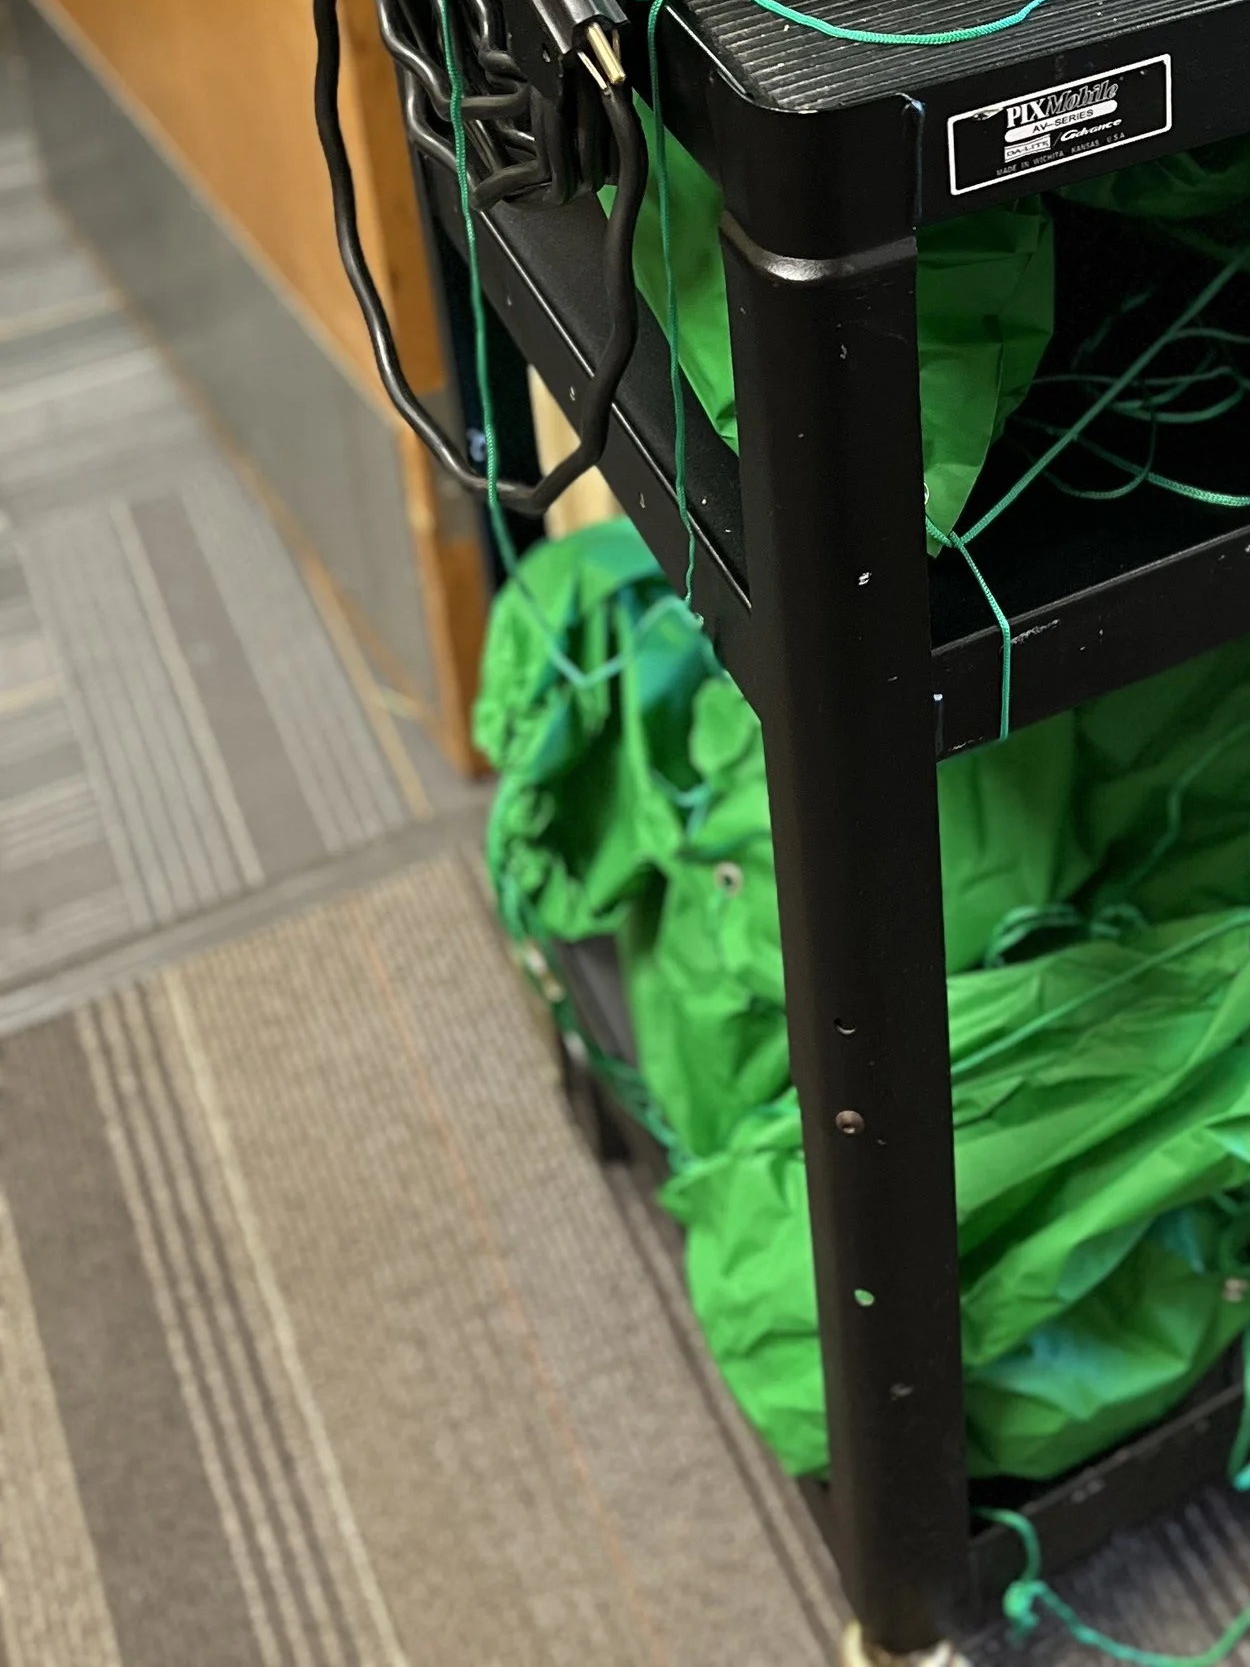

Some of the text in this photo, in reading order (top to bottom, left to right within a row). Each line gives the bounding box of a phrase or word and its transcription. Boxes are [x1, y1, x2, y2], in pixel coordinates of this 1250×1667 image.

[1032, 109, 1094, 134] AV-SERIES
[996, 164, 1017, 176] MADE
[1021, 160, 1030, 169] IN
[1071, 139, 1100, 154] KANSAS
